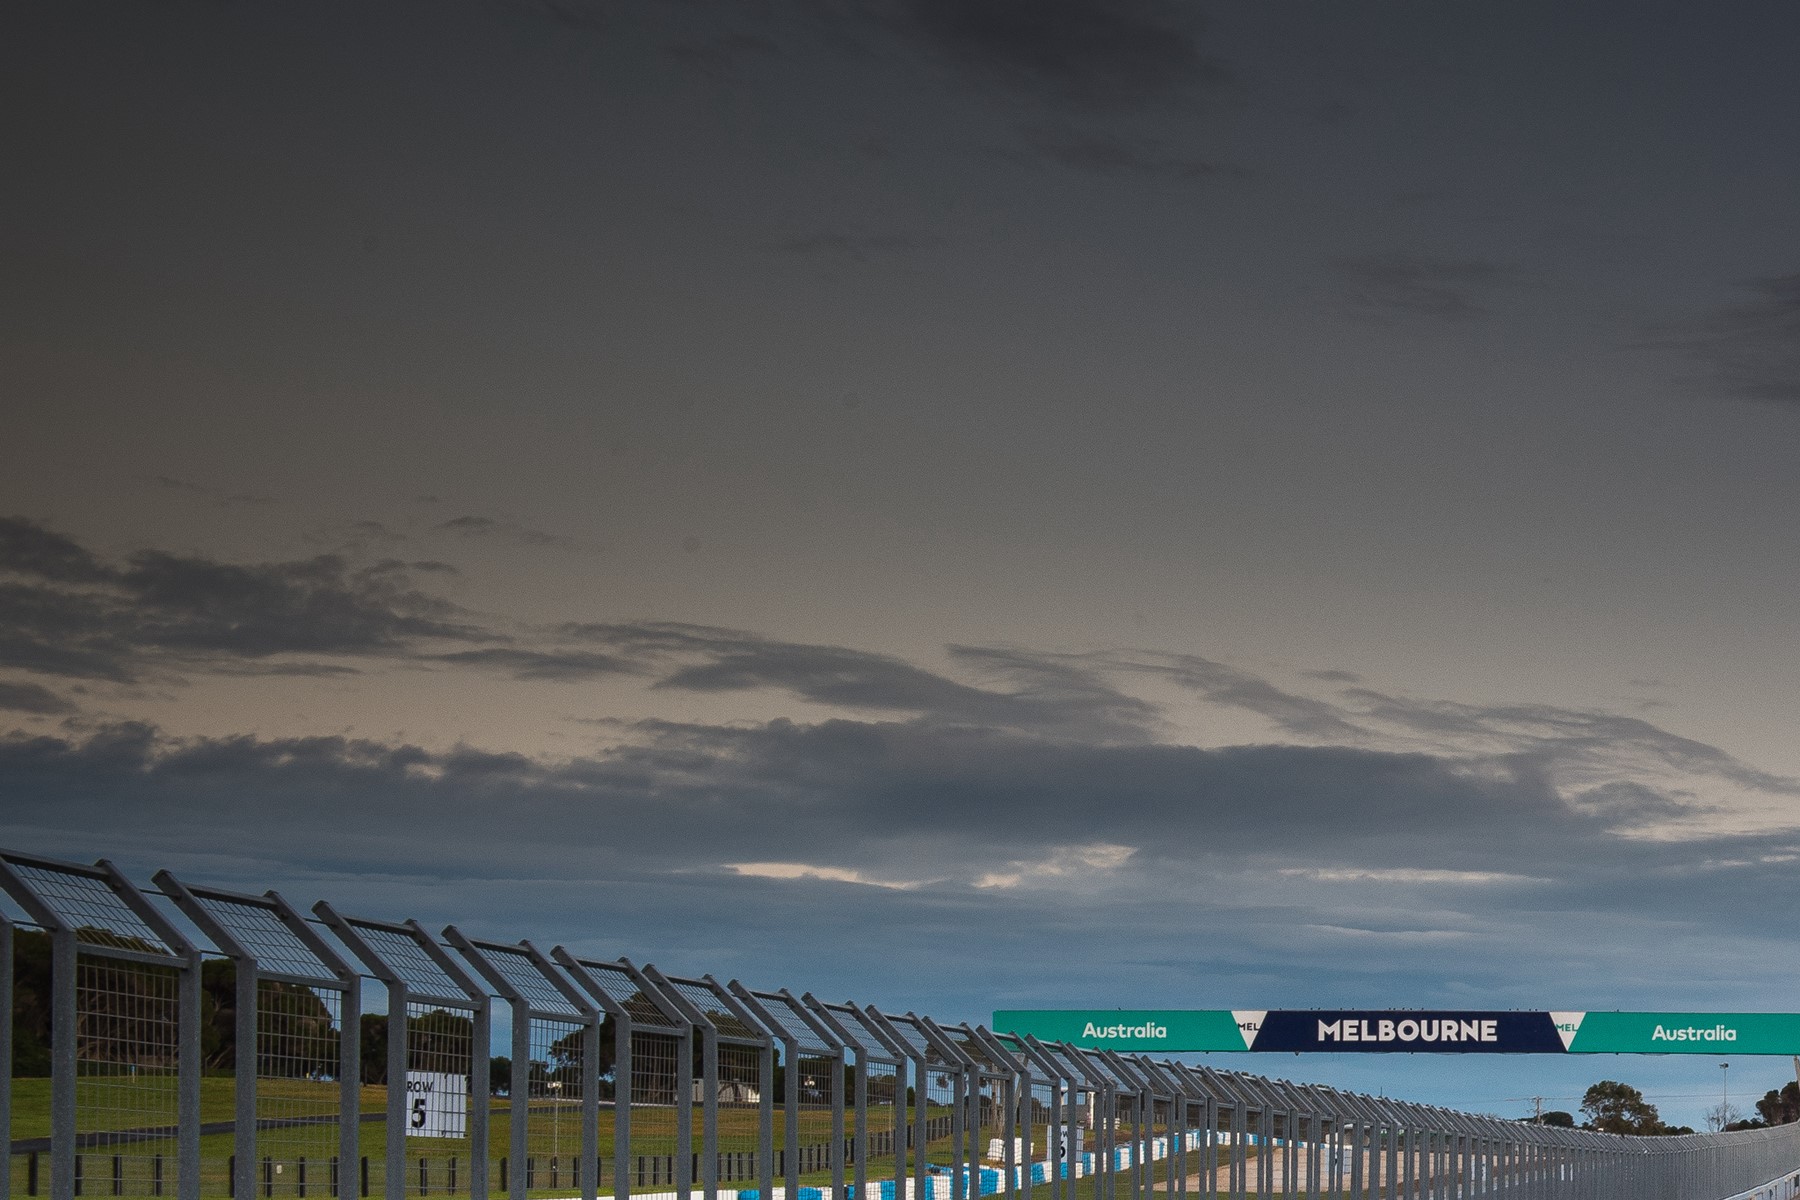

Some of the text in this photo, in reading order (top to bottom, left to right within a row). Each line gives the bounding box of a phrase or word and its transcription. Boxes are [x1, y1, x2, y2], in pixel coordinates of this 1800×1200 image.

[1082, 1022, 1167, 1039] Australia
[1317, 1019, 1498, 1042] MELBOURNE
[1651, 1024, 1737, 1041] Australia
[406, 1081, 434, 1093] ROW
[411, 1098, 426, 1129] 5
